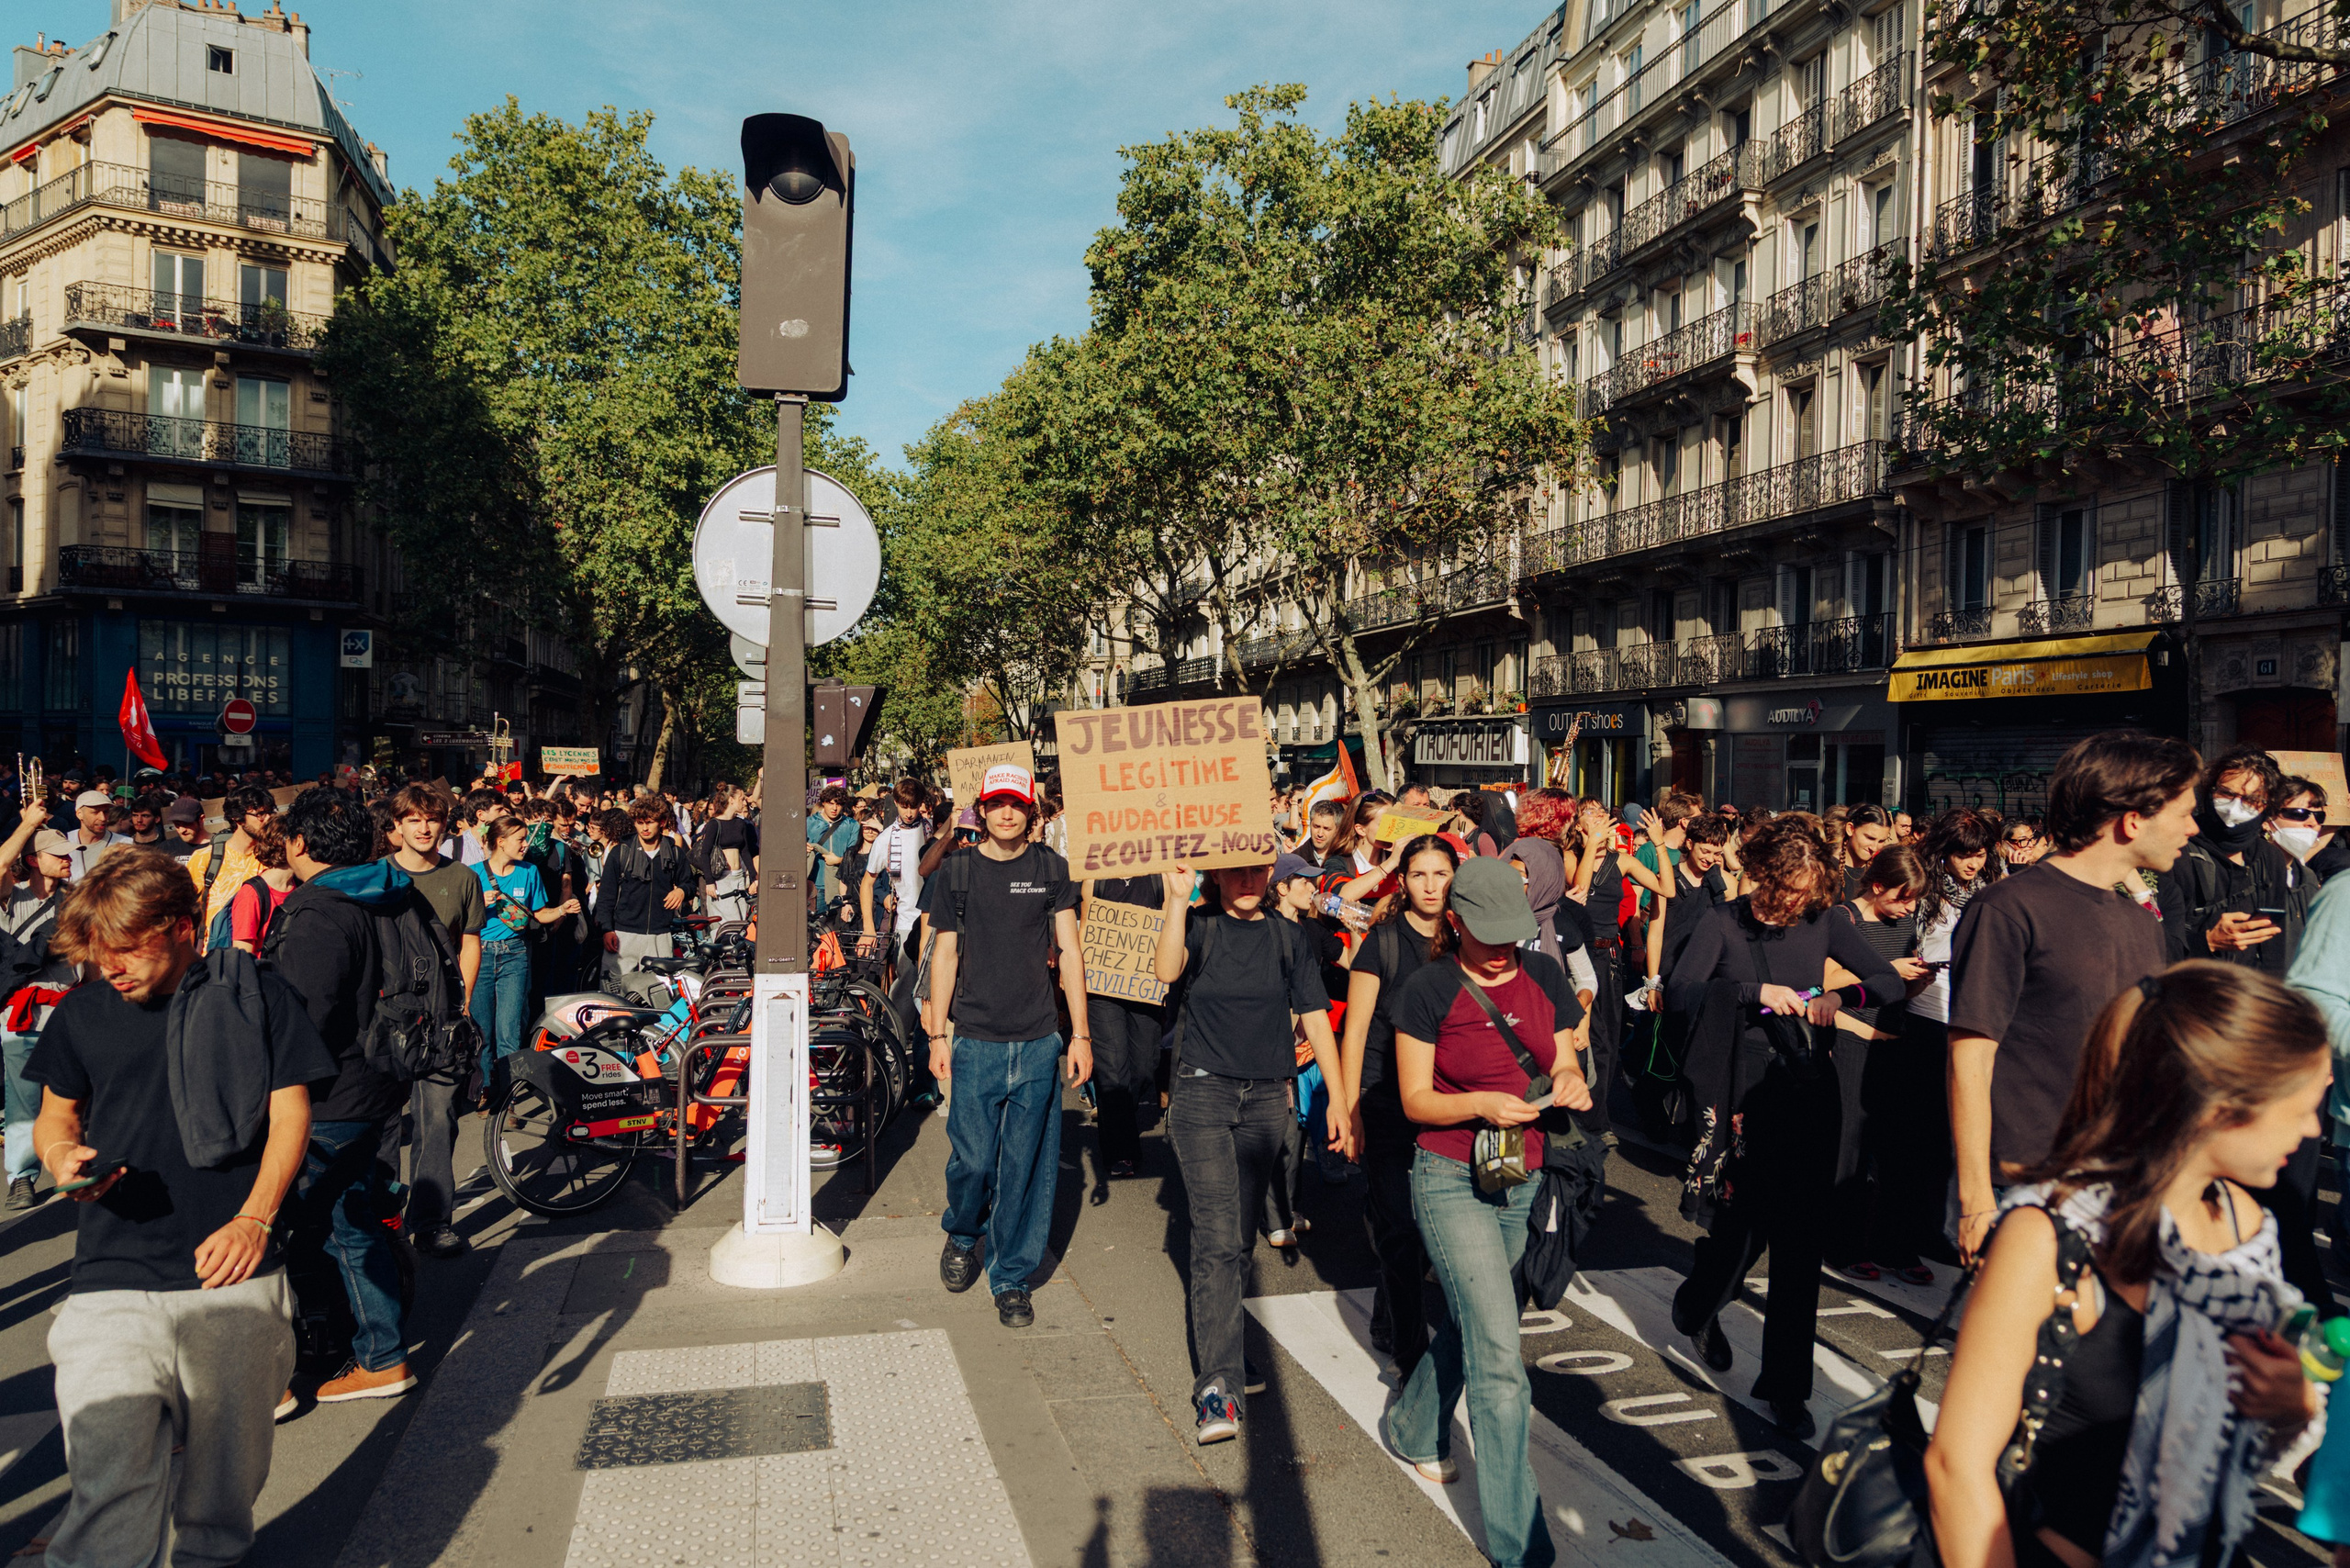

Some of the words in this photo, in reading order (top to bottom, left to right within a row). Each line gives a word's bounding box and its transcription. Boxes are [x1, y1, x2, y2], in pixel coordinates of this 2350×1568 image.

[154, 652, 279, 666] AGENCE
[2260, 661, 2272, 674] 61
[153, 672, 279, 689] PROFESSIONS
[1916, 669, 1987, 690] IMAGINE
[1992, 665, 2035, 686] Paris
[2052, 671, 2087, 681] Lifestyle
[2092, 670, 2113, 679] shop
[153, 688, 279, 703] LIBERAES
[1591, 710, 1623, 730] shoes
[1767, 708, 1813, 723] AUDILYA
[1067, 702, 1259, 755] JEUNESSE
[1417, 726, 1513, 761] TROIFOIRIEN
[956, 752, 1015, 772] DARMANIN
[972, 769, 987, 781] NU
[1006, 773, 1027, 784] RACISTS
[1011, 778, 1026, 789] AGAIN
[1155, 792, 1167, 808] &
[1084, 830, 1275, 870] ECOUTEZ-NOUS
[1087, 901, 1138, 928] ÉCOLES
[1082, 946, 1128, 970] CHEZ
[580, 1052, 600, 1079] 3
[601, 1063, 621, 1072] FREE
[581, 1091, 603, 1101] Move
[582, 1100, 608, 1111] spend
[609, 1098, 627, 1107] less.
[627, 1118, 647, 1126] STNV
